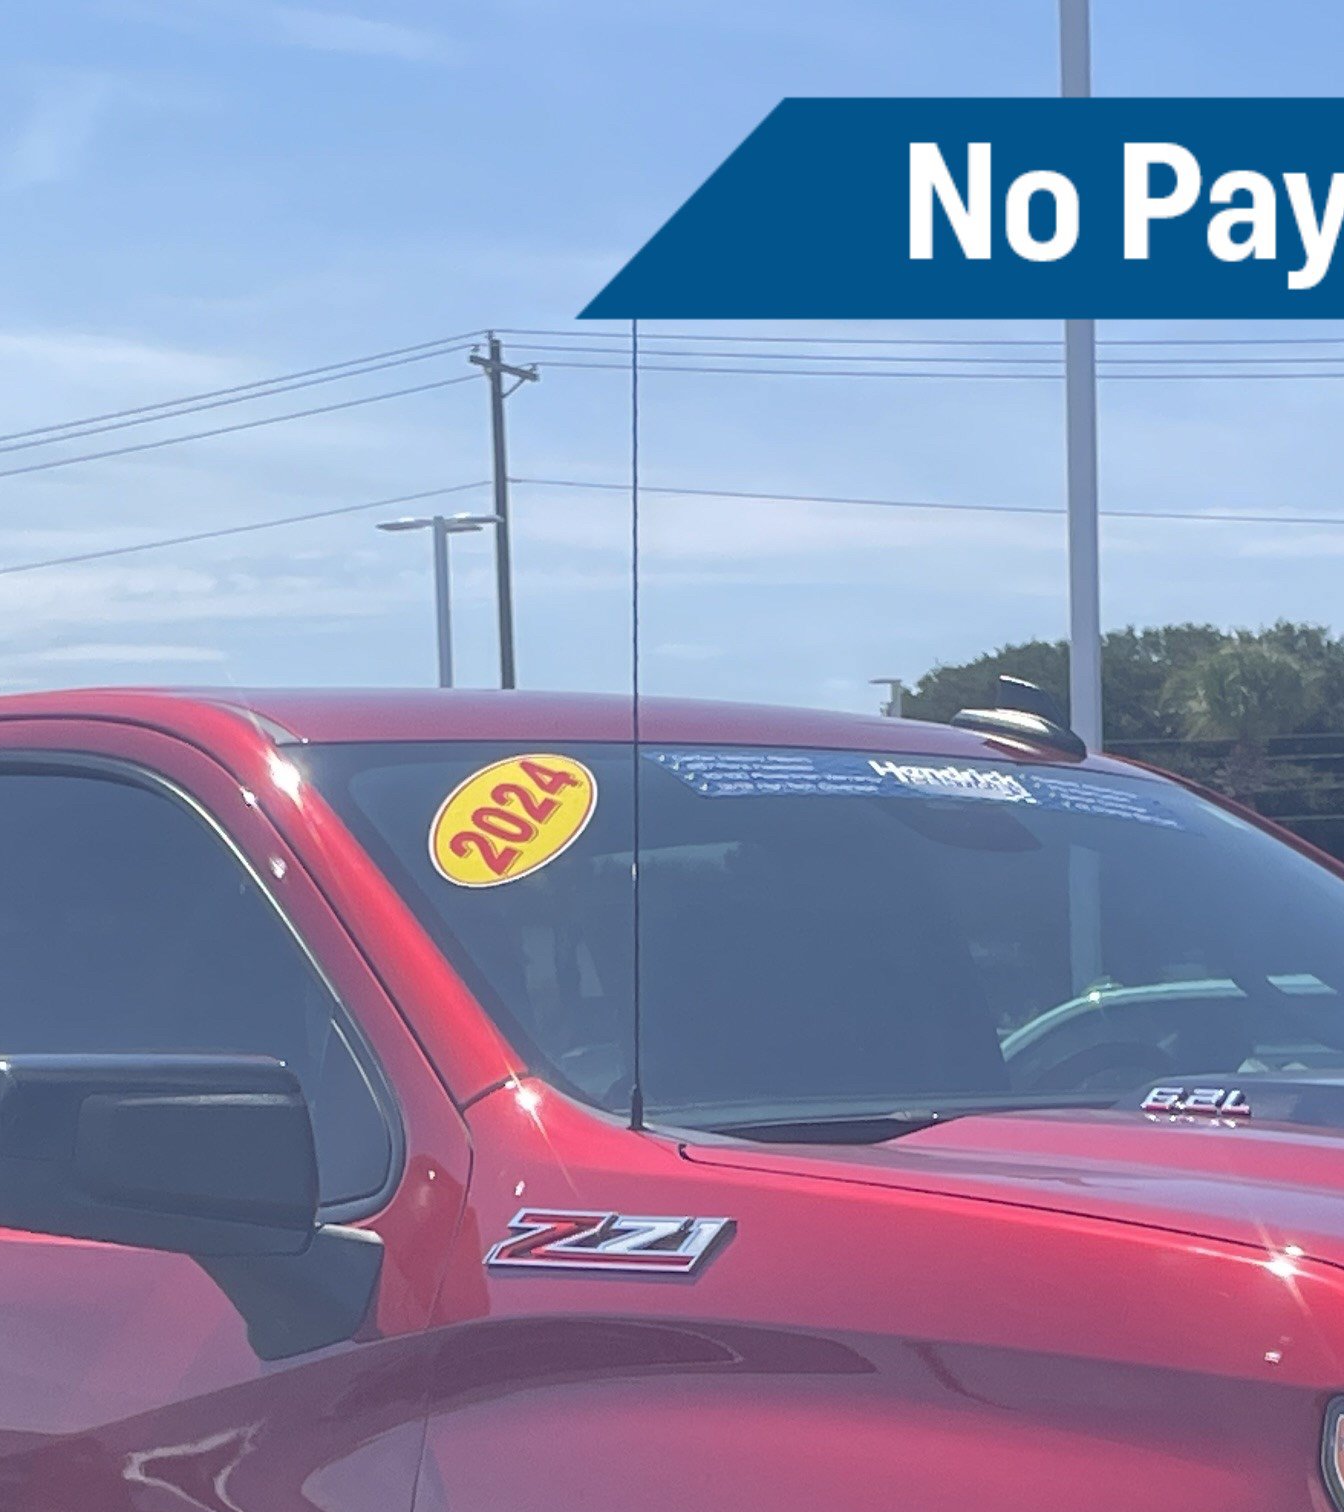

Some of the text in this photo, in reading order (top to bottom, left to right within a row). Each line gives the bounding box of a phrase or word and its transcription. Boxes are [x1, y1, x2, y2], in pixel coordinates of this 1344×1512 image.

[449, 761, 580, 876] 2024
[1140, 1086, 1251, 1115] 6.2L
[482, 1207, 738, 1272] Z71
